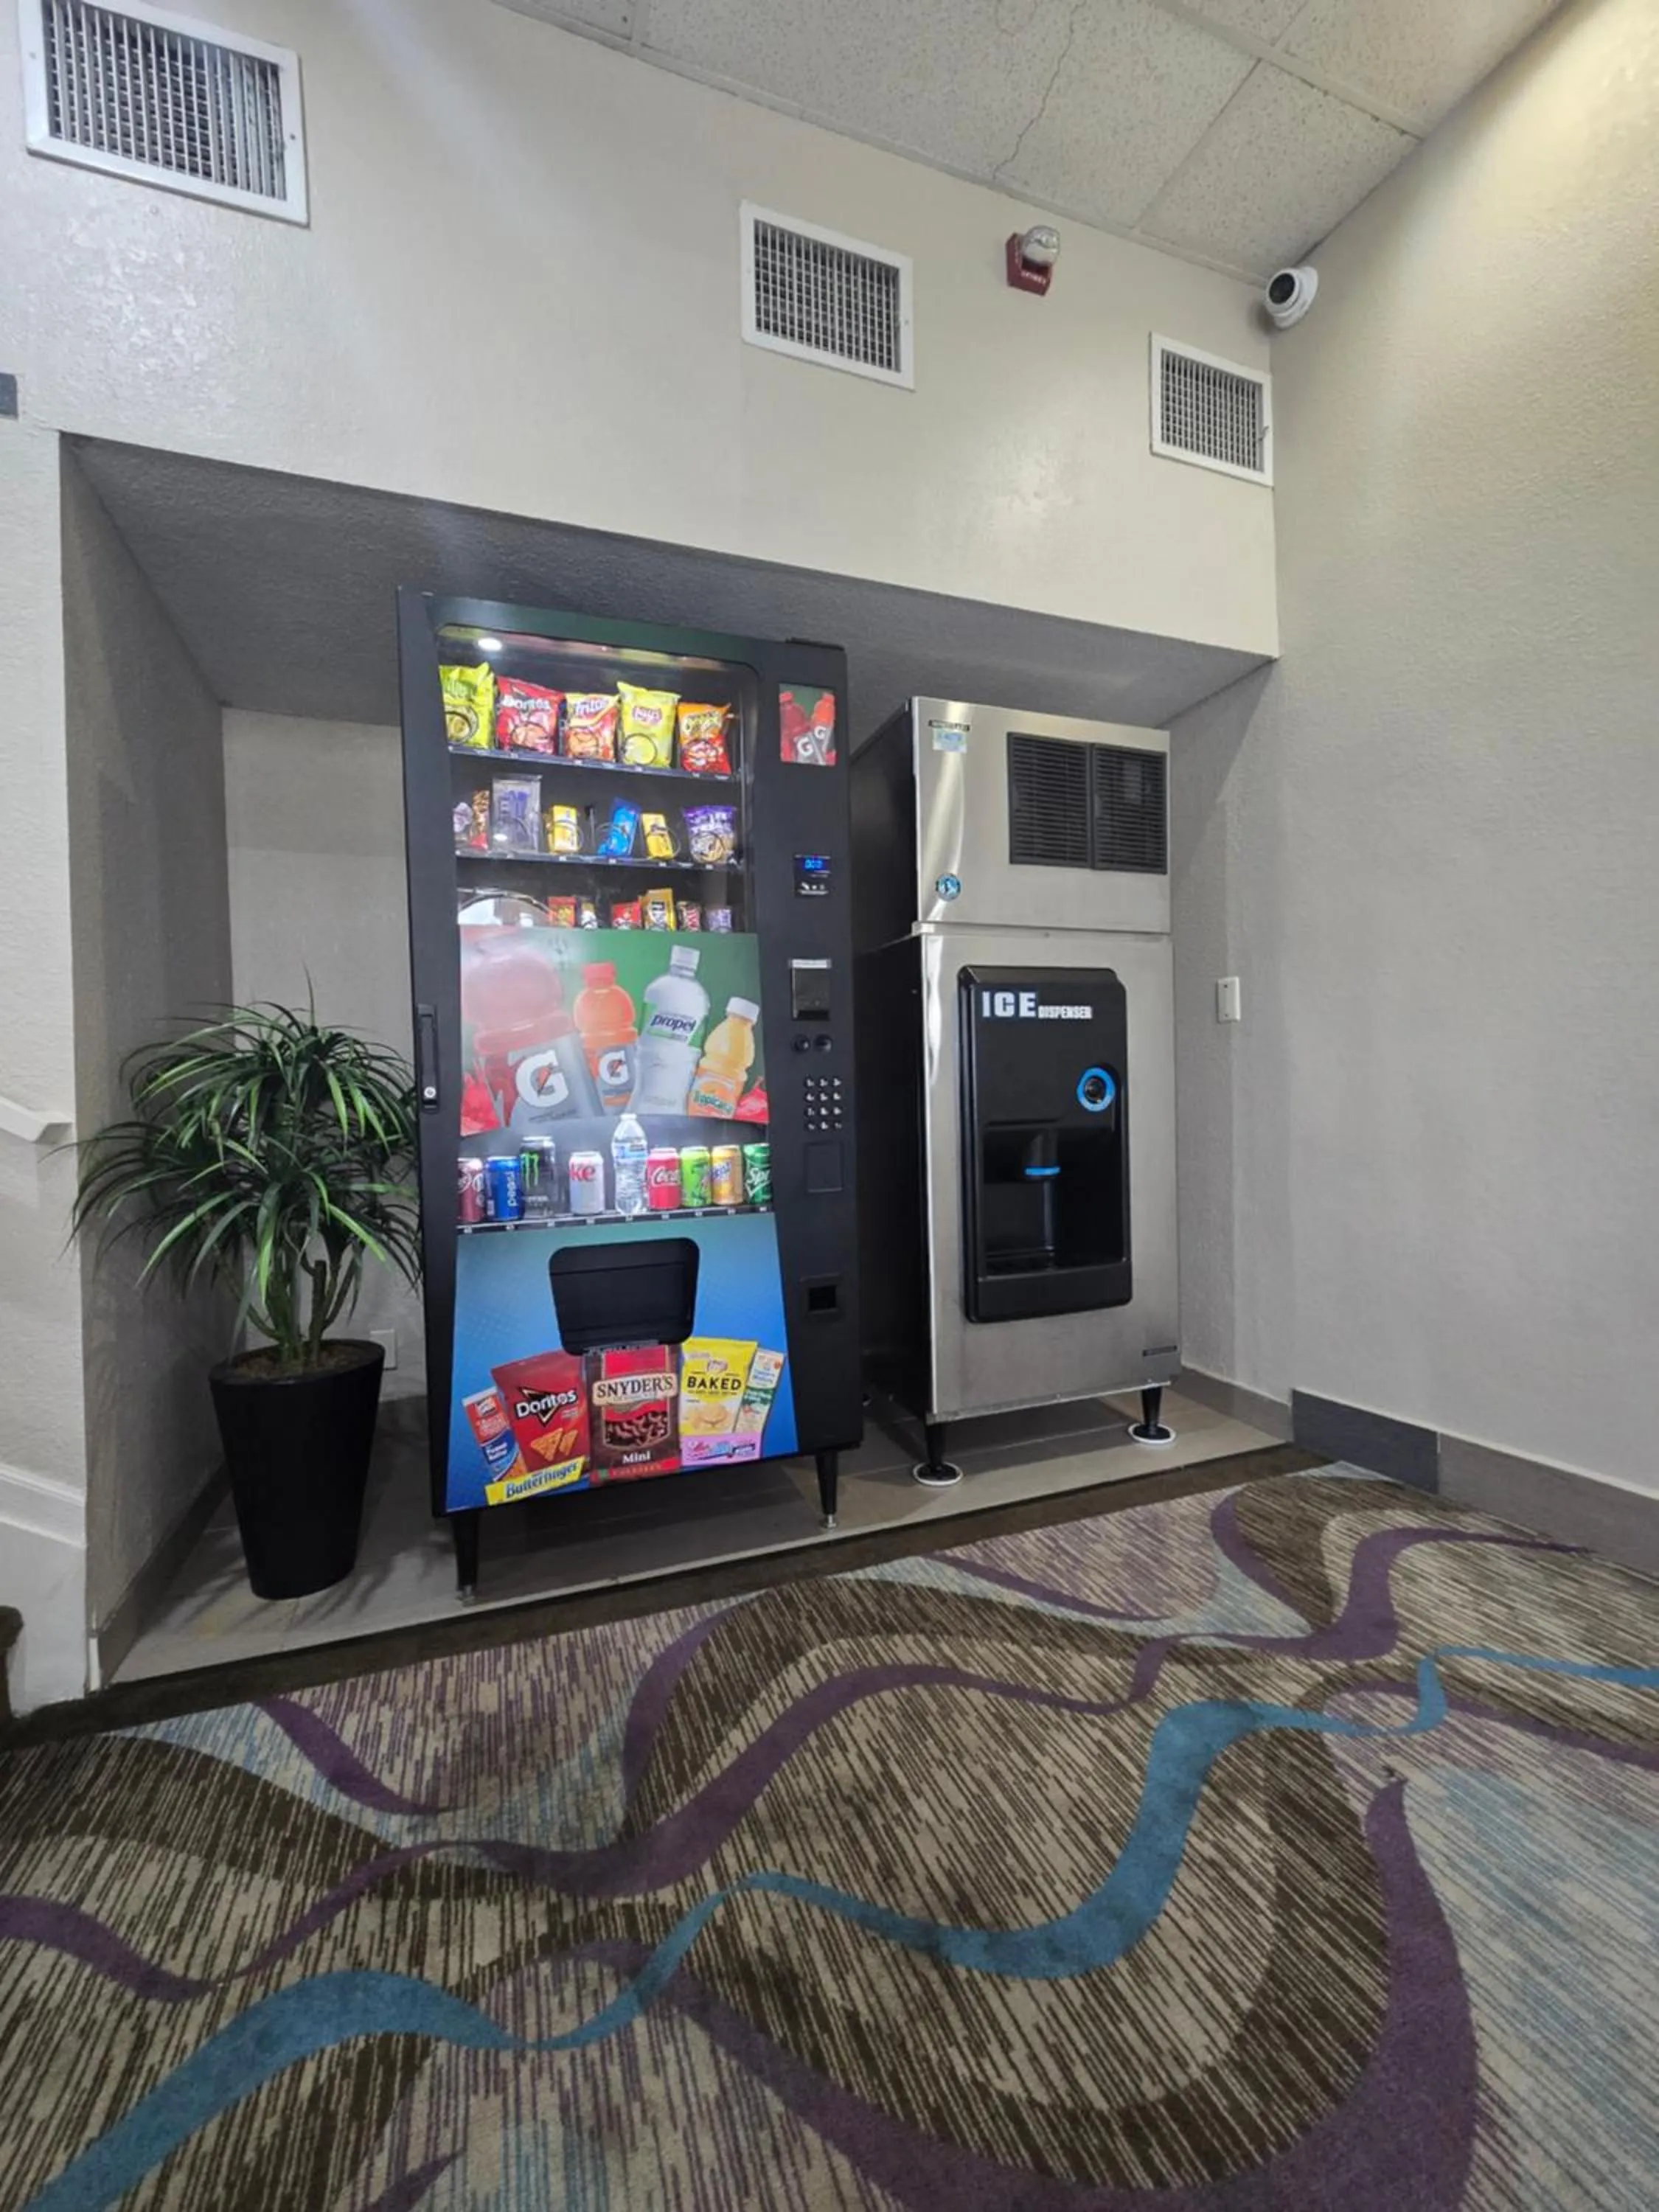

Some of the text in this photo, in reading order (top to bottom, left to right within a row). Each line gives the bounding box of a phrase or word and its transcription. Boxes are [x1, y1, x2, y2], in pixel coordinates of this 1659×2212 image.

[981, 991, 1092, 1020] ICE DISPENSER
[650, 1014, 697, 1032] propel
[686, 1375, 742, 1391] BAKED
[516, 1389, 578, 1418] Doritos
[622, 1450, 651, 1464] Mini
[505, 1461, 579, 1498] Butterfinger
